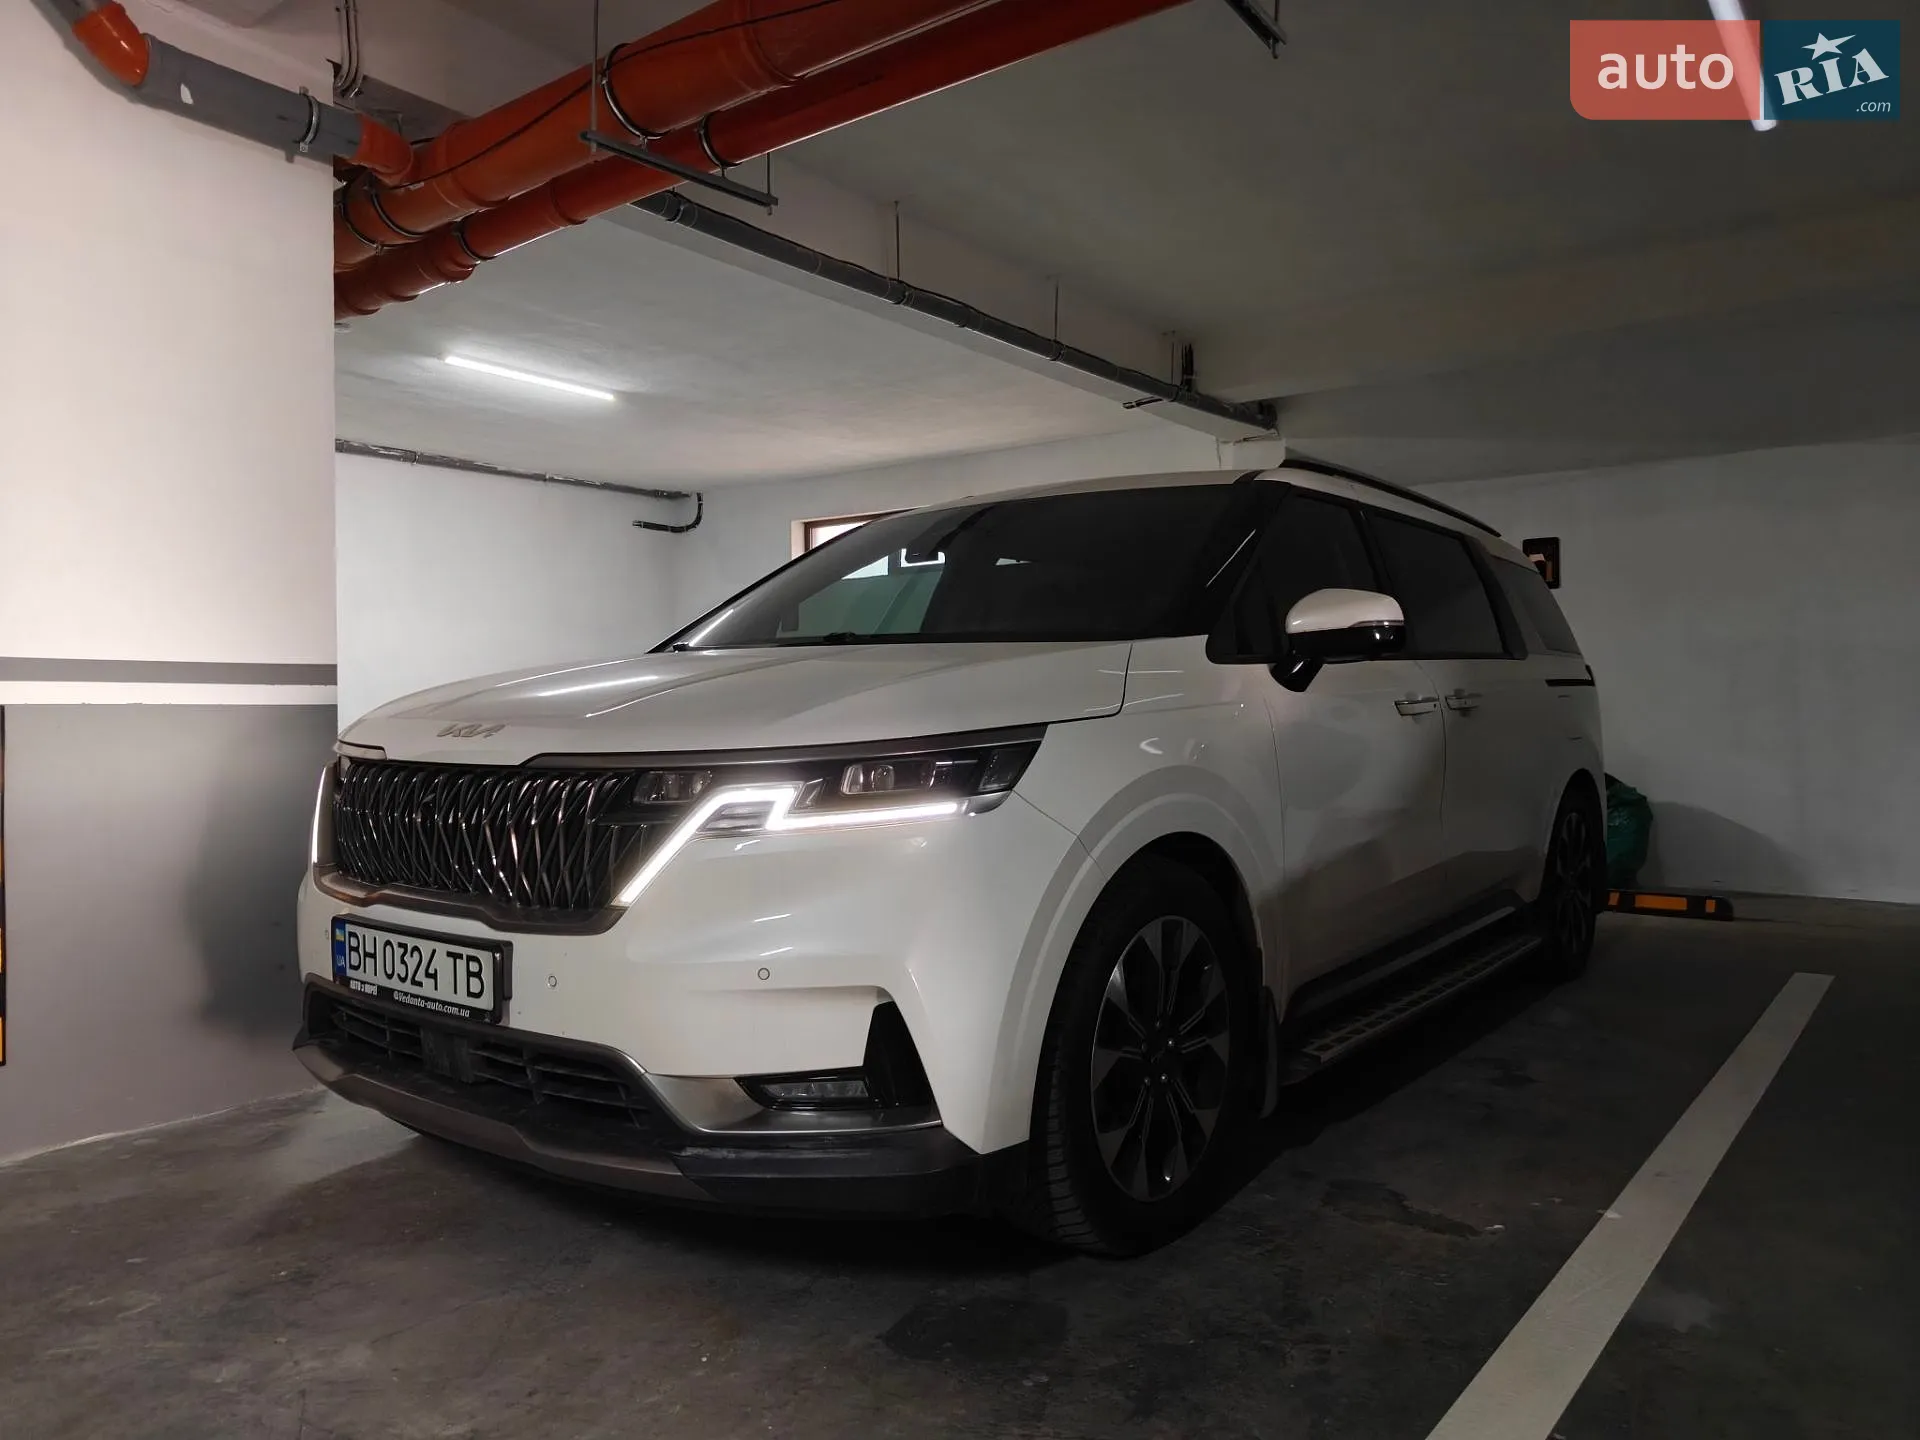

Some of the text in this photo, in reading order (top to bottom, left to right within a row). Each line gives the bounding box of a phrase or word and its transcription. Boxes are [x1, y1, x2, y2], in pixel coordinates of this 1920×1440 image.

[336, 955, 345, 968] UA
[348, 931, 485, 999] BH 0324 TB
